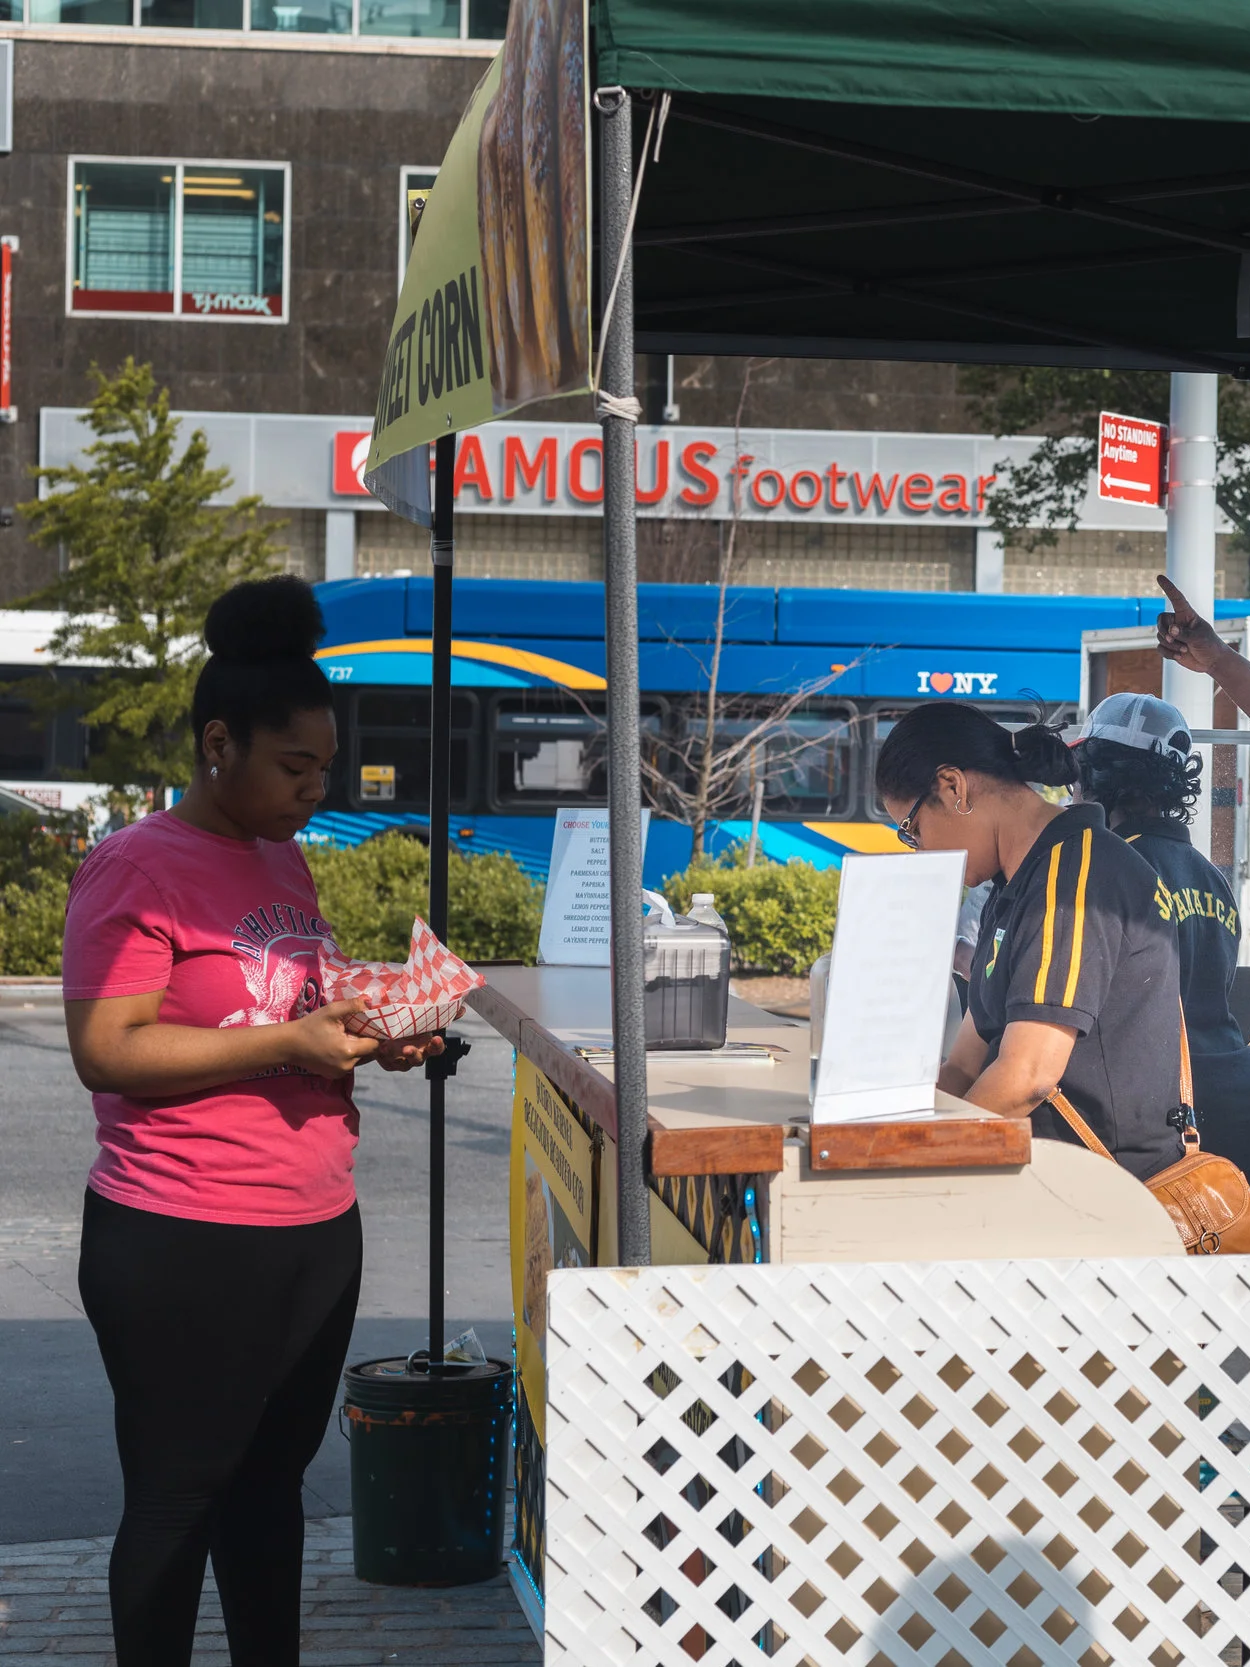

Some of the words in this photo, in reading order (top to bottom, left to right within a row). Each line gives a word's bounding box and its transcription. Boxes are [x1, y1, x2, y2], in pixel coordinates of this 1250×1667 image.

[418, 265, 484, 406] CORN
[1104, 422, 1116, 440] NO
[1117, 425, 1158, 448] STANDING
[1103, 442, 1138, 463] Anytime
[430, 434, 720, 506] AMOUS
[730, 455, 997, 512] footwear
[917, 671, 930, 693] I
[563, 821, 589, 829] CHOOSE
[1171, 887, 1238, 936] AMAICA
